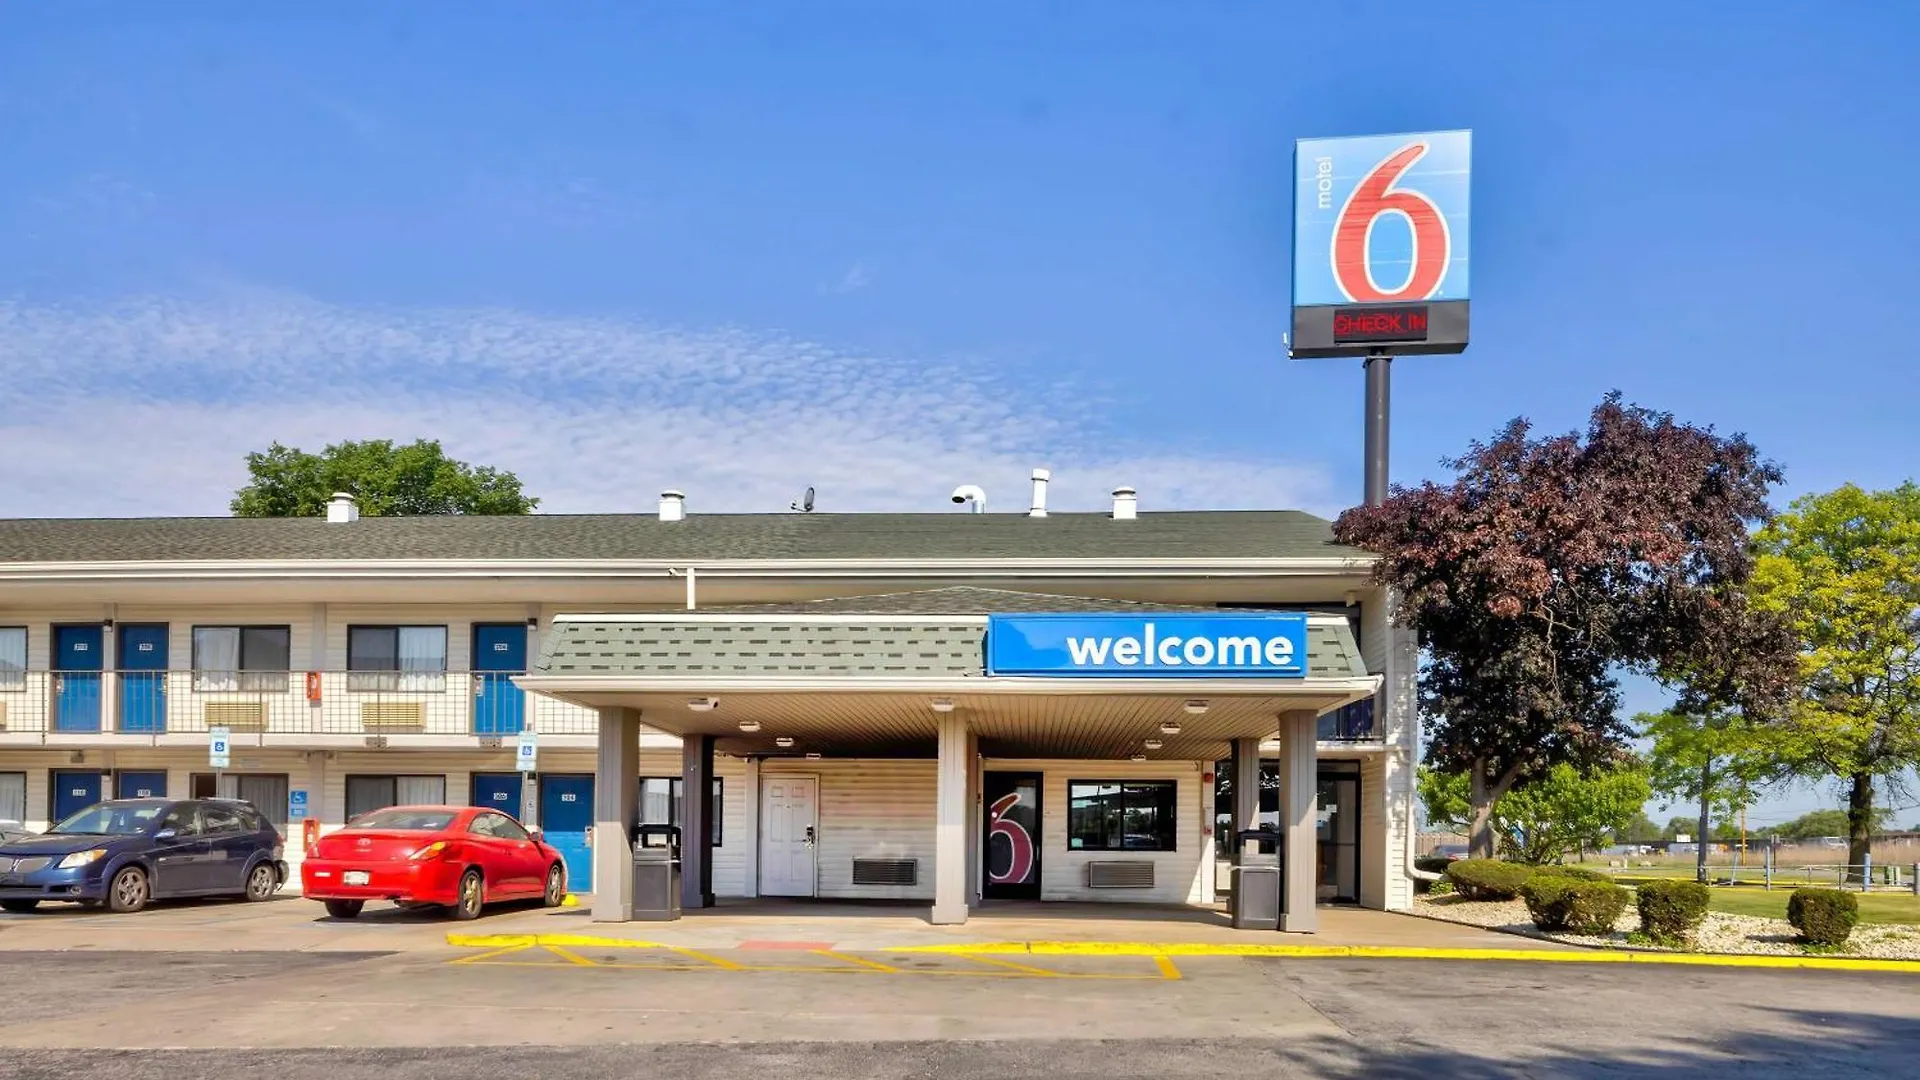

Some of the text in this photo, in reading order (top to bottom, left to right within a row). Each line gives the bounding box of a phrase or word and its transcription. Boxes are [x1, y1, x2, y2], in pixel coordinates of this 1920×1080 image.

[1316, 156, 1332, 209] motel
[1330, 138, 1451, 302] 6
[1334, 311, 1427, 336] CHECK IN
[1066, 622, 1294, 666] welcome
[989, 792, 1034, 884] 6
